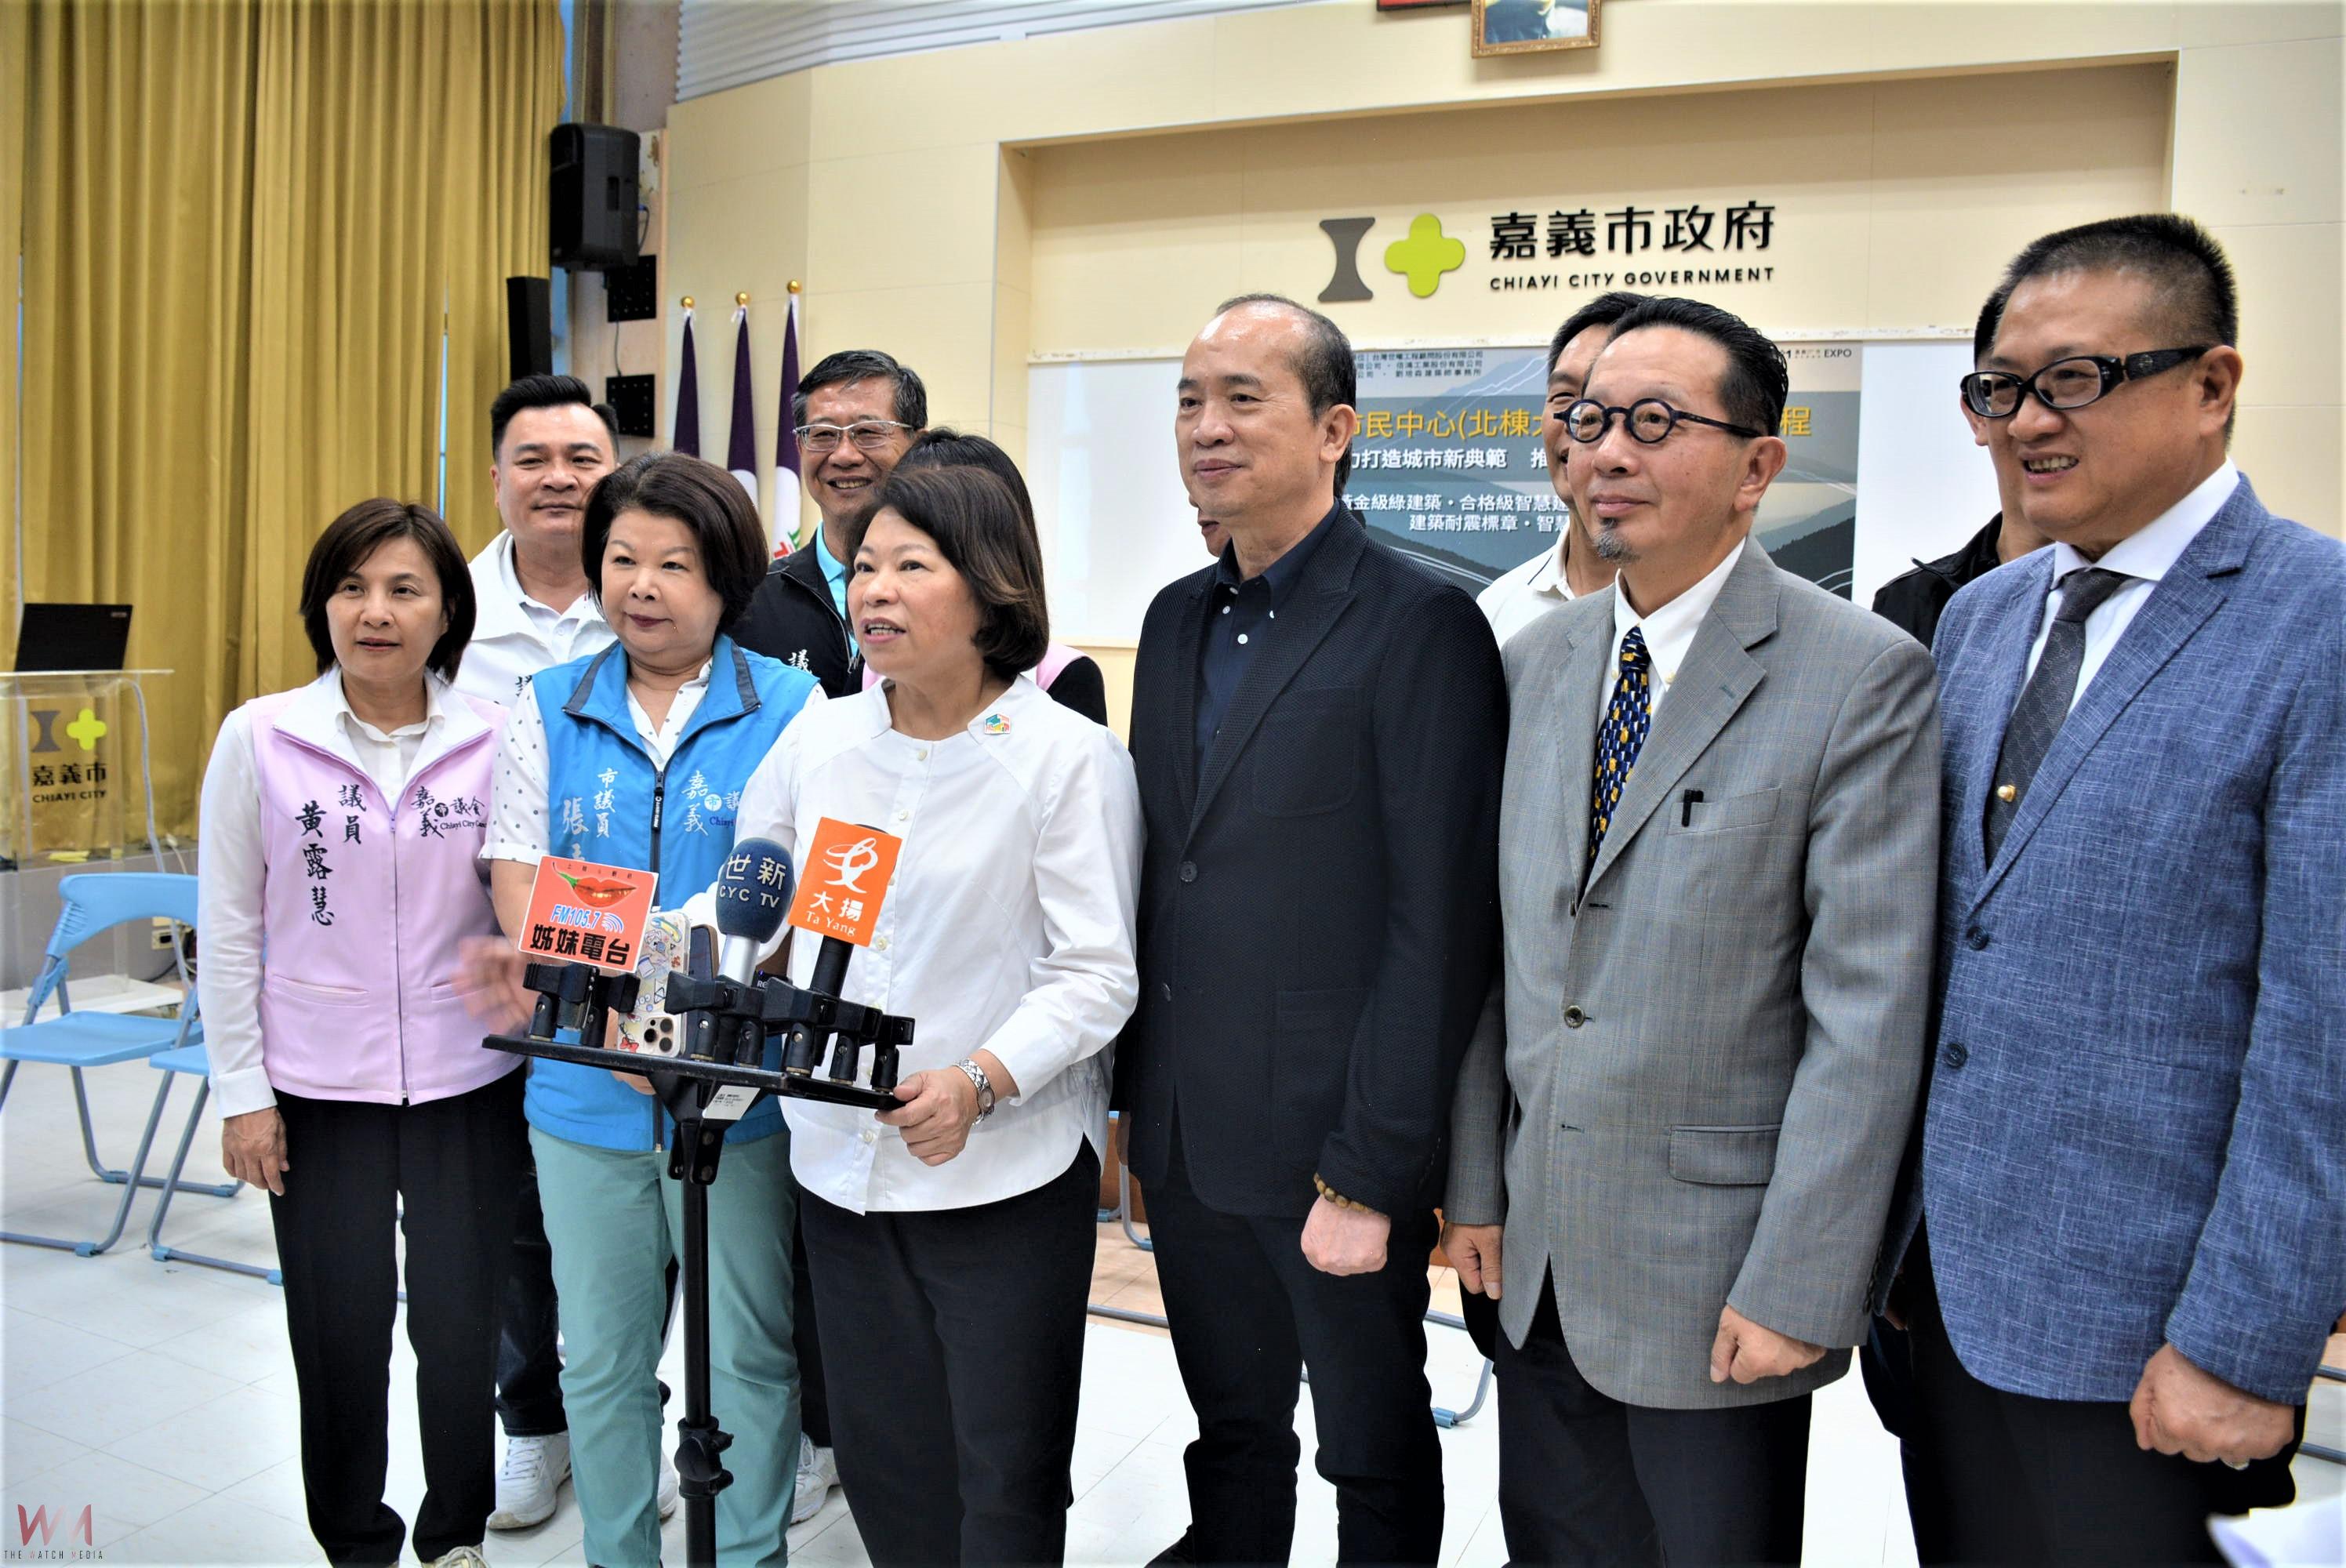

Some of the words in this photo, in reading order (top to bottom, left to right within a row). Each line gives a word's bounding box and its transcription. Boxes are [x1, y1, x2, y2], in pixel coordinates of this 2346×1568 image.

[1490, 201, 1776, 260] 嘉義市政府
[1490, 274, 1559, 291] CHIAYI
[1568, 272, 1615, 289] CITY
[1624, 267, 1775, 285] GOVERNMENT
[1824, 348, 1852, 358] EXPO
[1781, 406, 1812, 437] 程
[32, 762, 108, 786] 嘉義市
[32, 792, 76, 803] CHIAYI
[80, 789, 107, 800] CITY
[338, 784, 367, 844] 議員
[295, 800, 335, 926] 黃露慧
[725, 854, 786, 891] 世新
[719, 885, 750, 902] CYC
[760, 892, 780, 908] TV
[810, 891, 864, 922] 大揚
[550, 904, 601, 929] FM105.7
[806, 910, 820, 925] Ta
[826, 916, 857, 937] Yang
[530, 924, 630, 965] 姊妹電台
